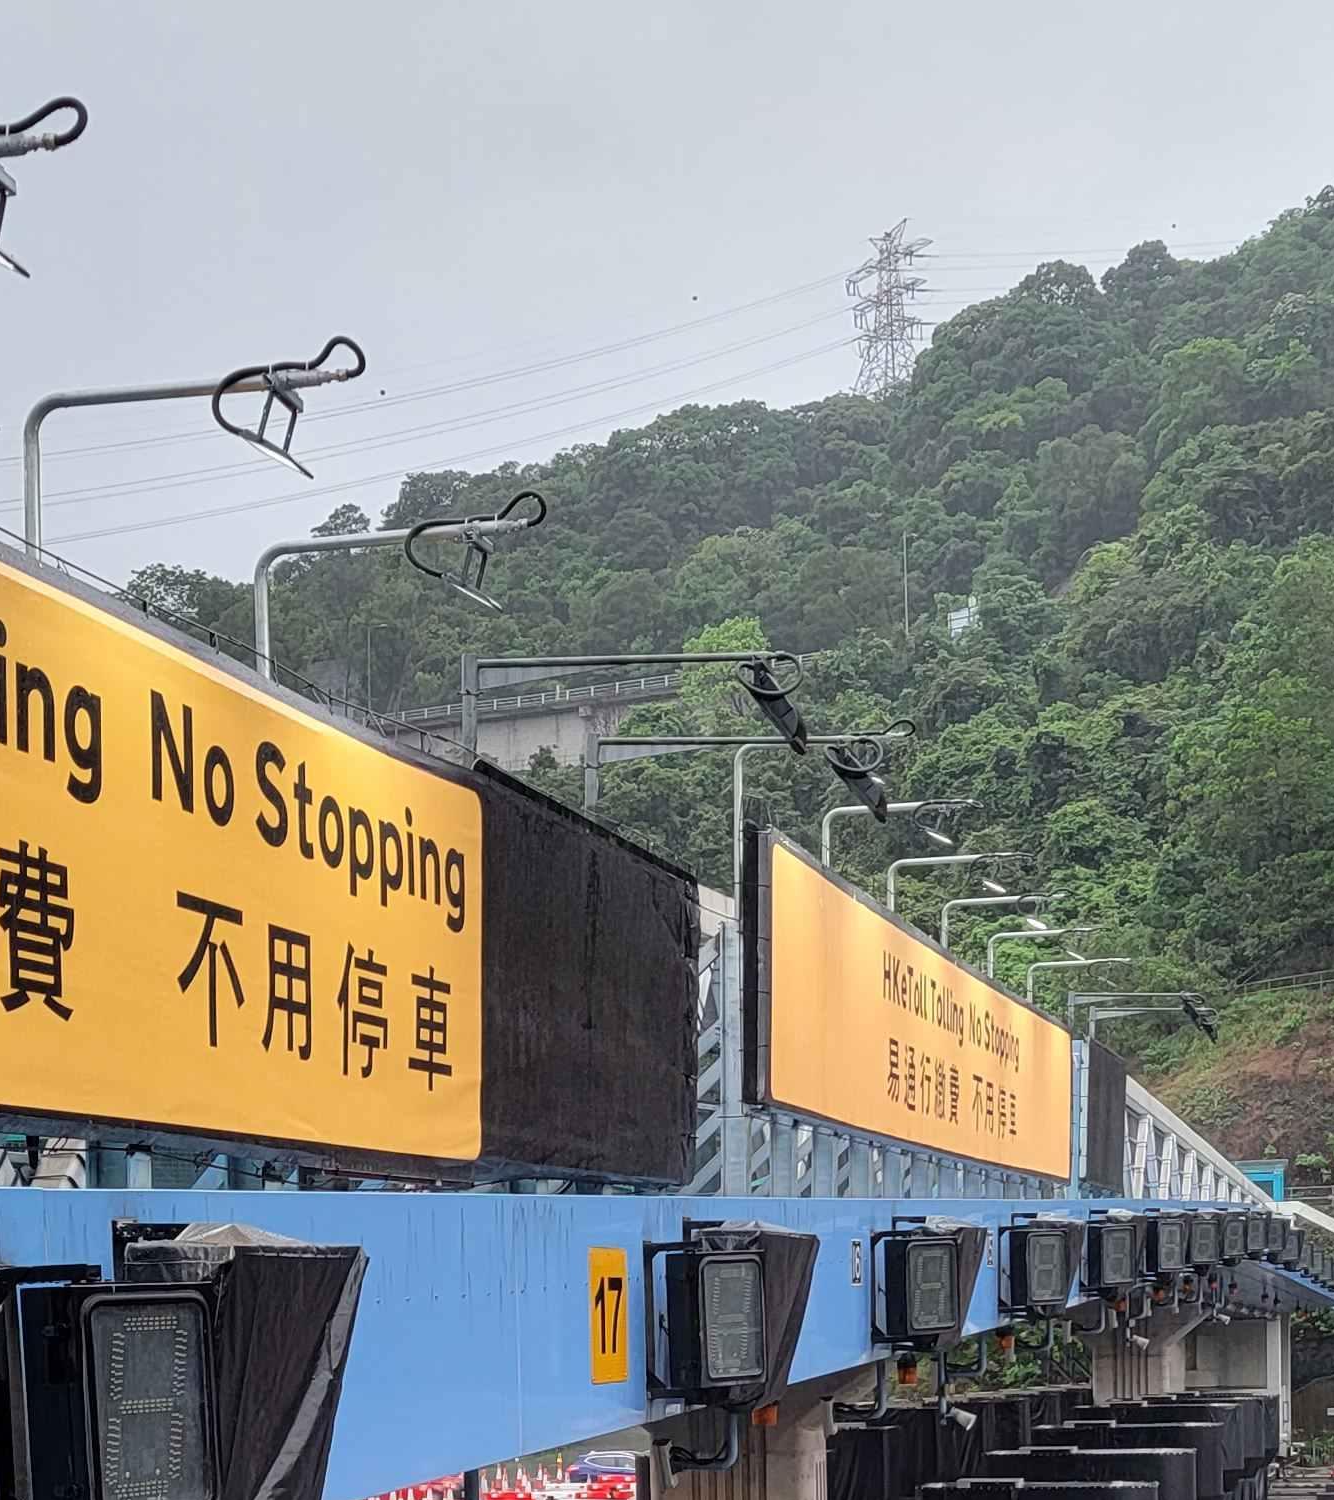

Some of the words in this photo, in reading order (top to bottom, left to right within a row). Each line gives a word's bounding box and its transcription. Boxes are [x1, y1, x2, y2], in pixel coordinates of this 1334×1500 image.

[151, 689, 235, 827] No
[256, 741, 466, 934] Stopping
[176, 890, 454, 1092] 不用停車
[883, 950, 928, 1022] HKeToll
[931, 981, 964, 1047] Tolling
[969, 1002, 982, 1047] No
[984, 1011, 1020, 1073] Stopping
[595, 1276, 623, 1354] 17
